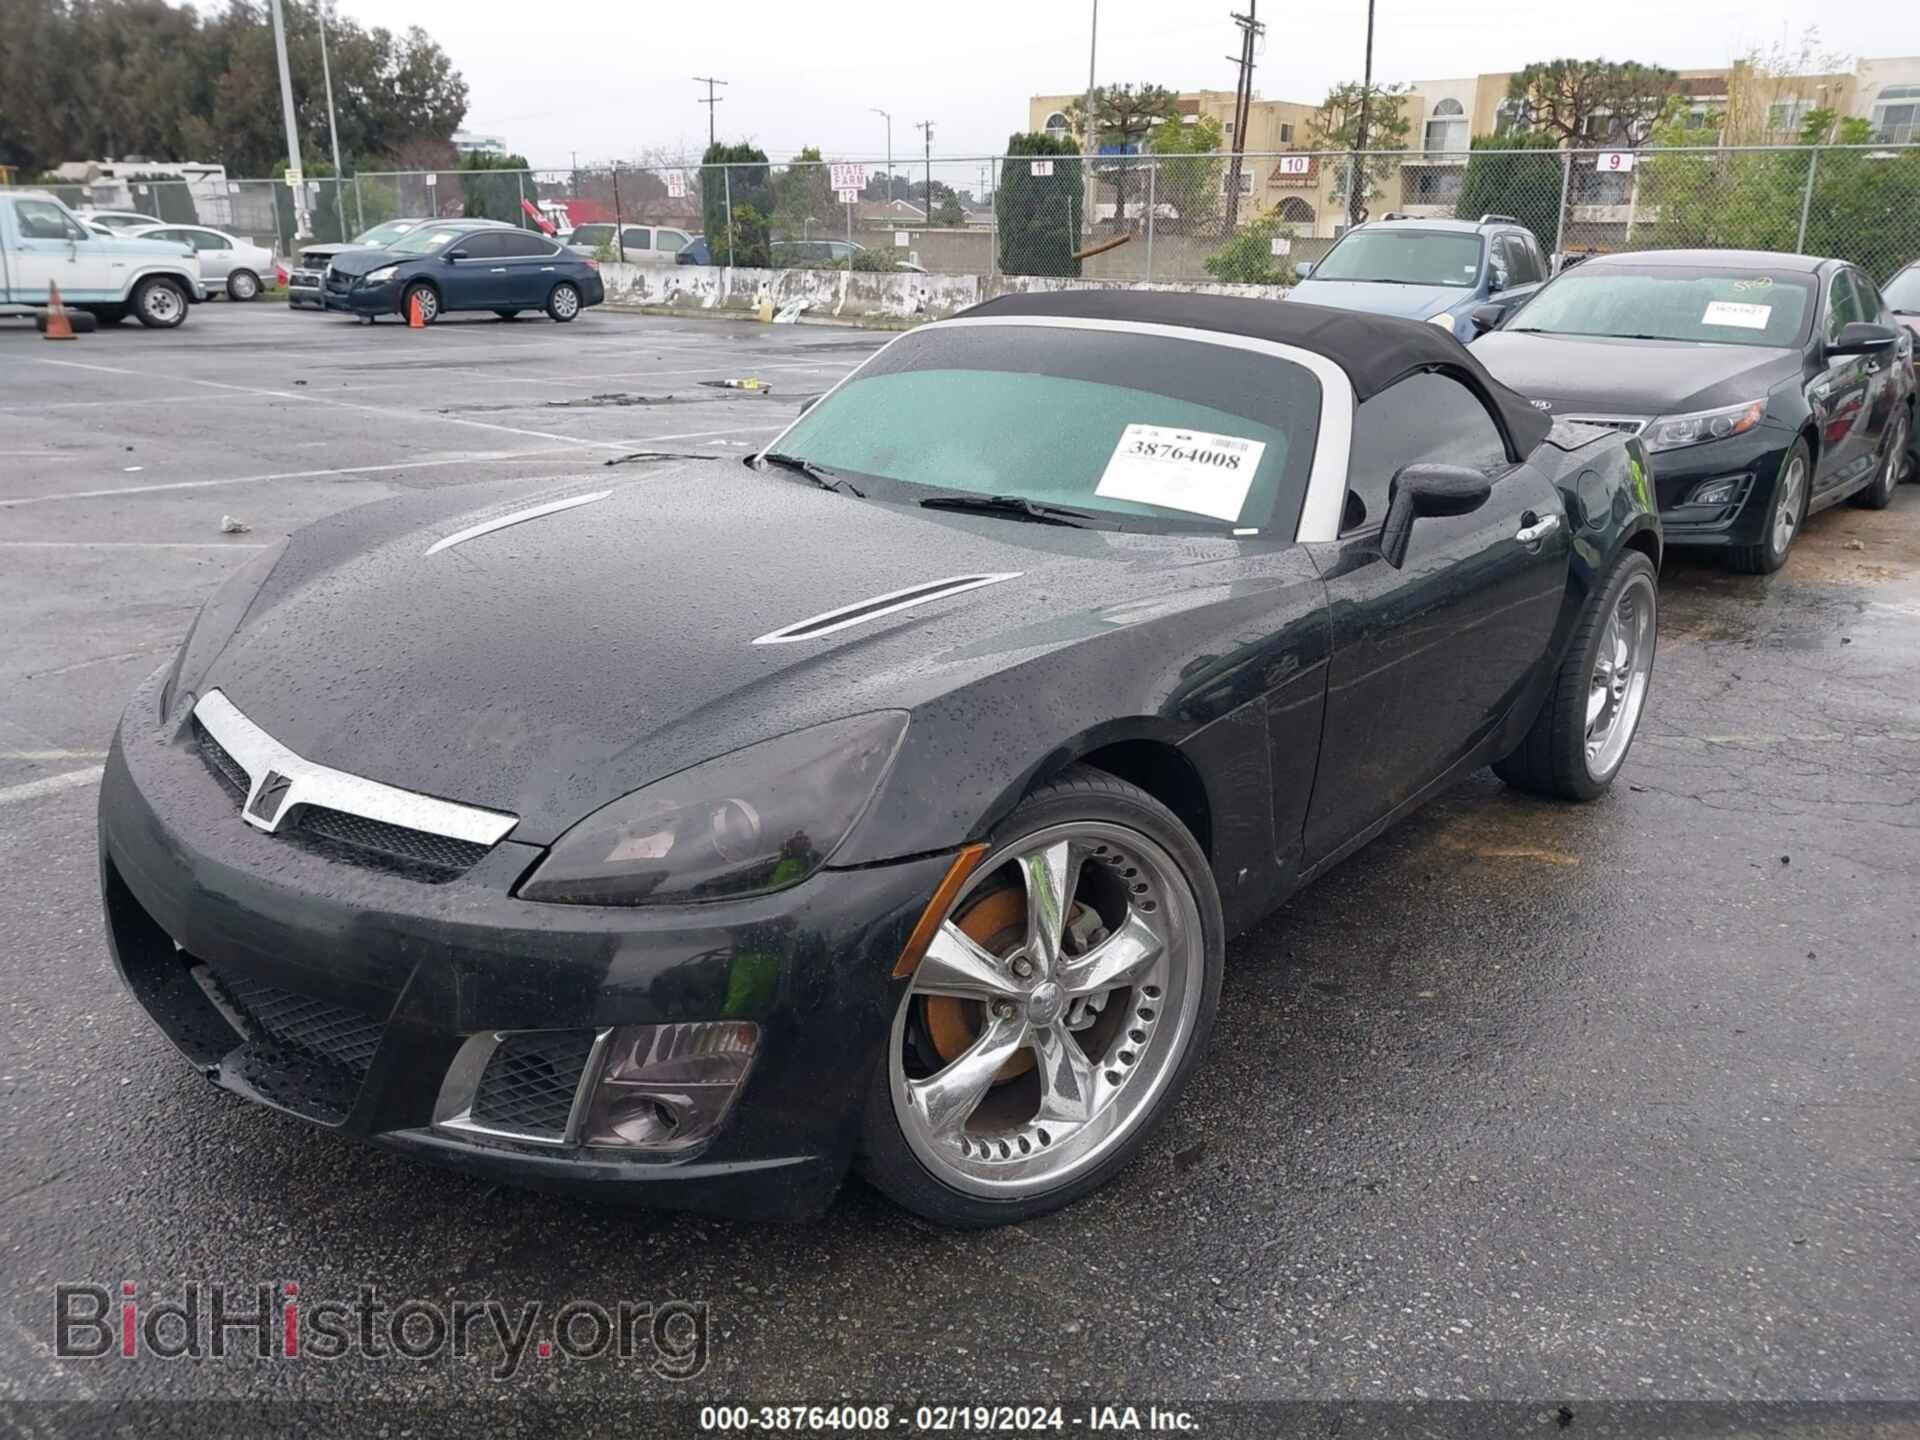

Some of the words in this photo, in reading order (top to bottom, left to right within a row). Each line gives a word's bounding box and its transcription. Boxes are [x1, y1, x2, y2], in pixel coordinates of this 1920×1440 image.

[1035, 162, 1046, 174] 11
[1288, 158, 1304, 172] 10
[1609, 154, 1621, 170] 9
[833, 164, 865, 175] STATE
[834, 175, 865, 185] FARM
[840, 190, 856, 202] 12
[1129, 440, 1241, 469] 38764008
